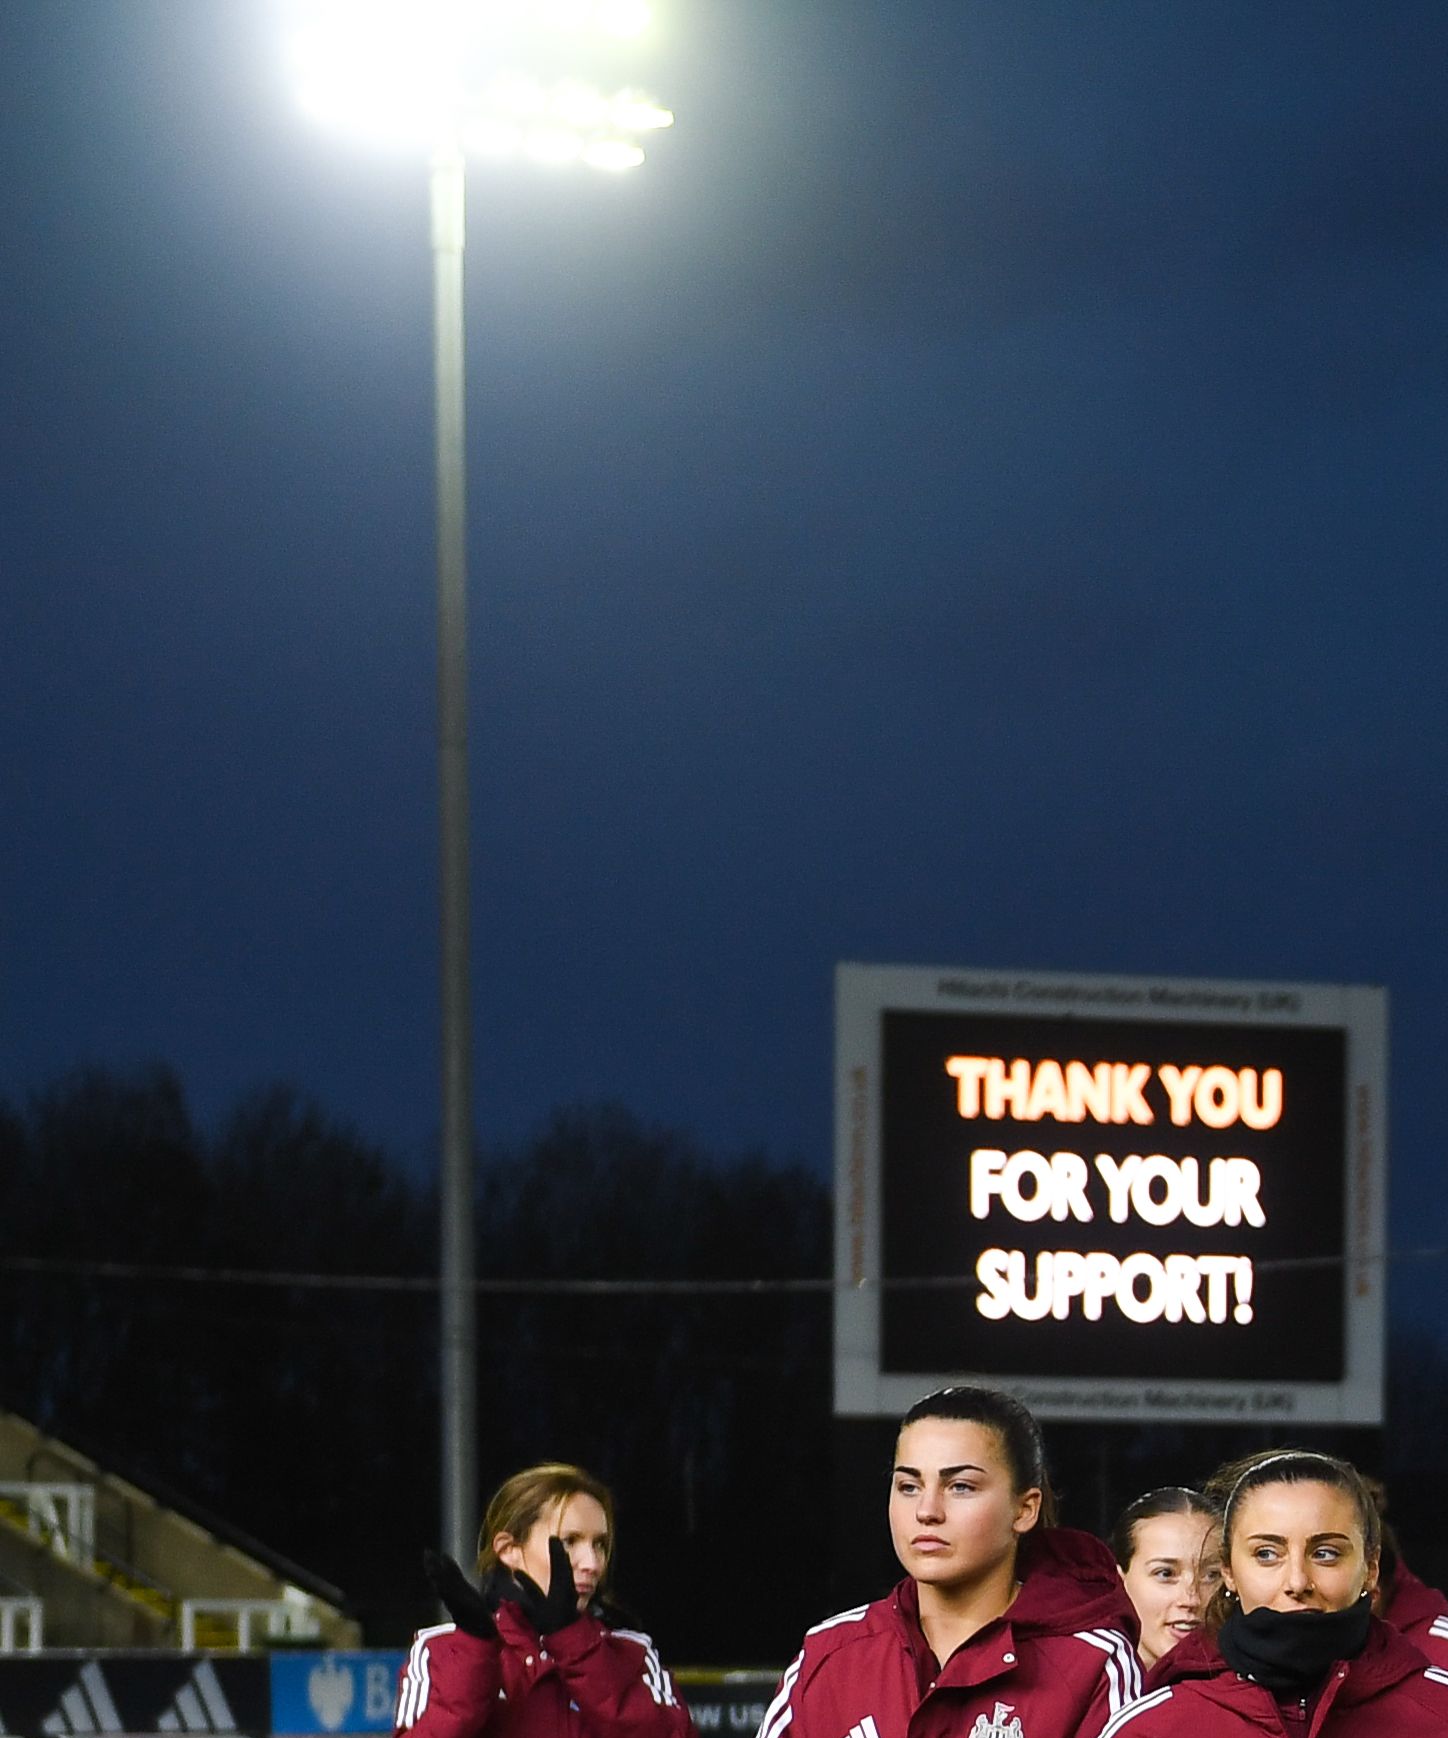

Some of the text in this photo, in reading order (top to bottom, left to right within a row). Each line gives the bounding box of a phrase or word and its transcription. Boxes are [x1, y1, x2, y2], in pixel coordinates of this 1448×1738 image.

[945, 1056, 1283, 1130] THANK YOU
[970, 1149, 1267, 1228] FOR YOUR
[976, 1248, 1254, 1326] SUPPORT!
